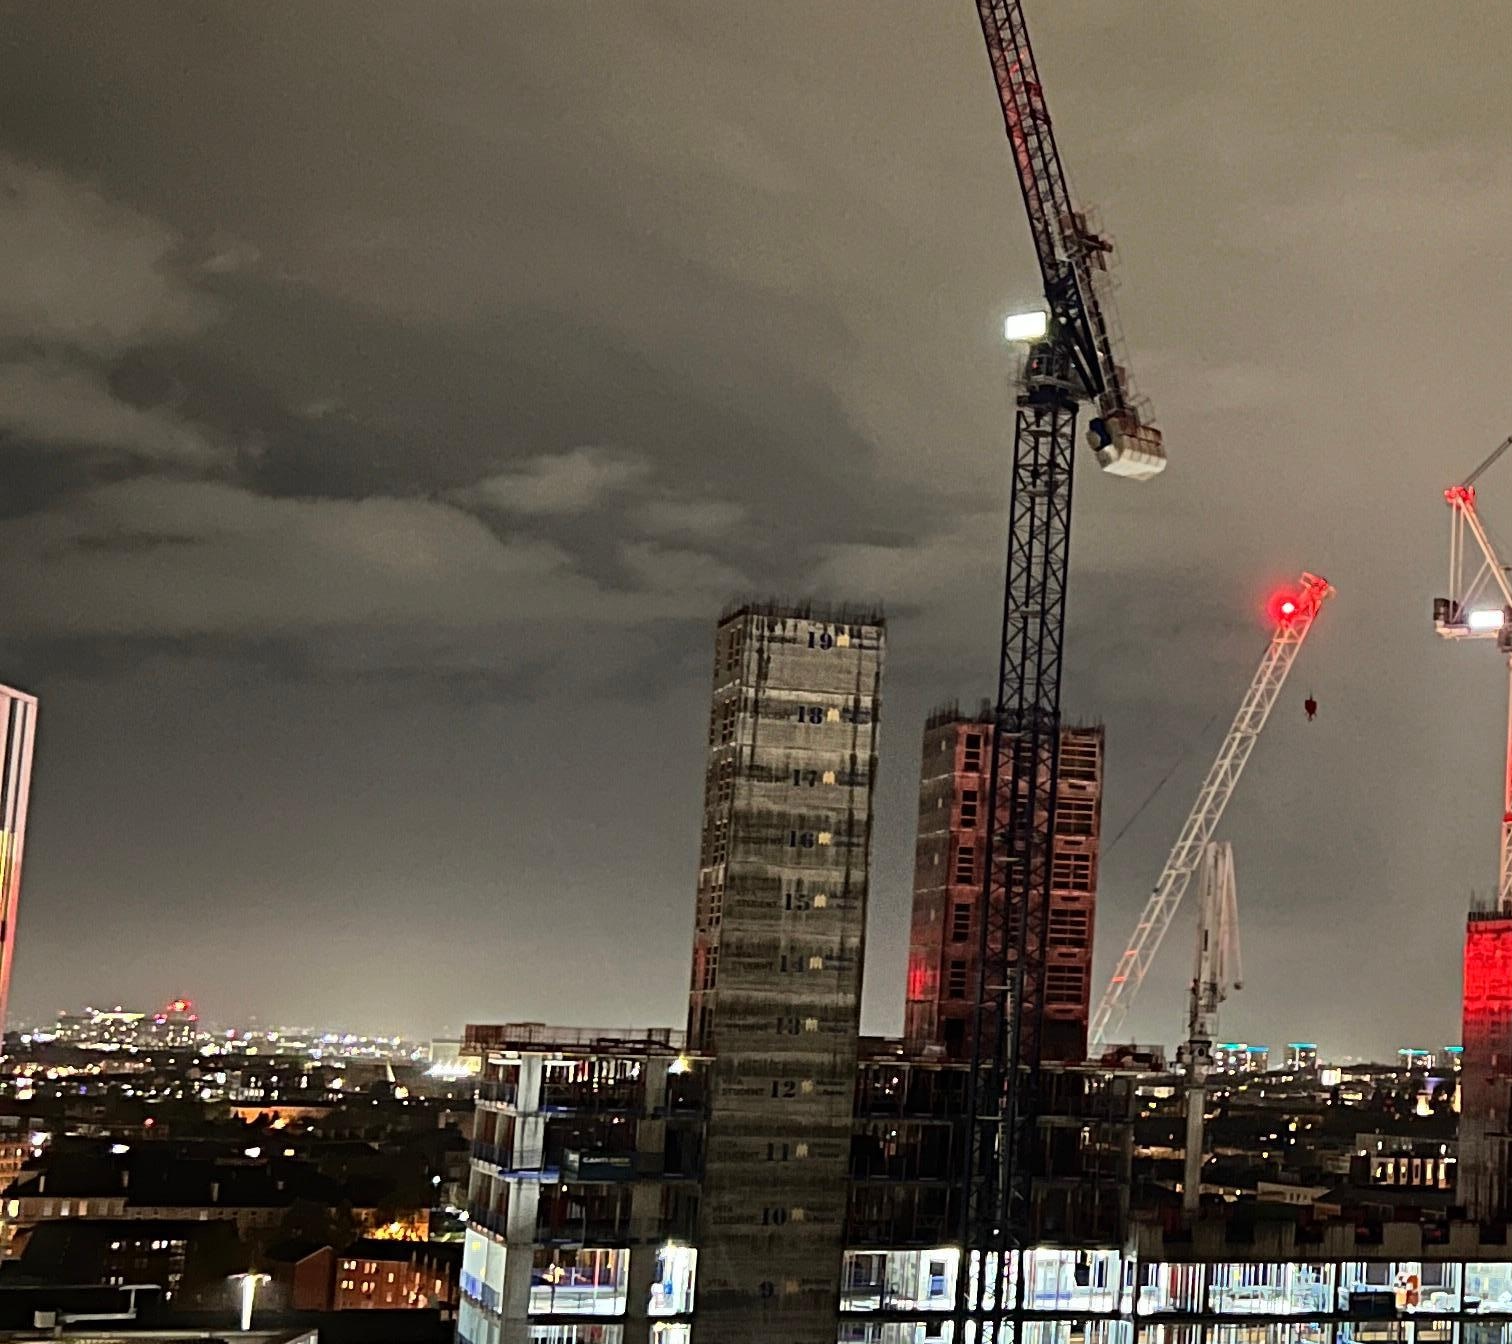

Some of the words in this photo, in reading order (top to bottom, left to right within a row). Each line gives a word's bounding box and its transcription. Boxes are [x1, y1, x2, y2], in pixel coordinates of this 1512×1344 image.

[808, 631, 833, 650] 19
[799, 706, 823, 724] 18
[793, 769, 818, 787] 17
[789, 830, 814, 848] 16
[785, 892, 810, 911] 15
[780, 954, 804, 973] 14
[776, 1017, 800, 1036] 13
[771, 1080, 796, 1098] 12
[767, 1142, 789, 1161] 11
[762, 1207, 787, 1226] 10
[759, 1280, 775, 1297] 9
